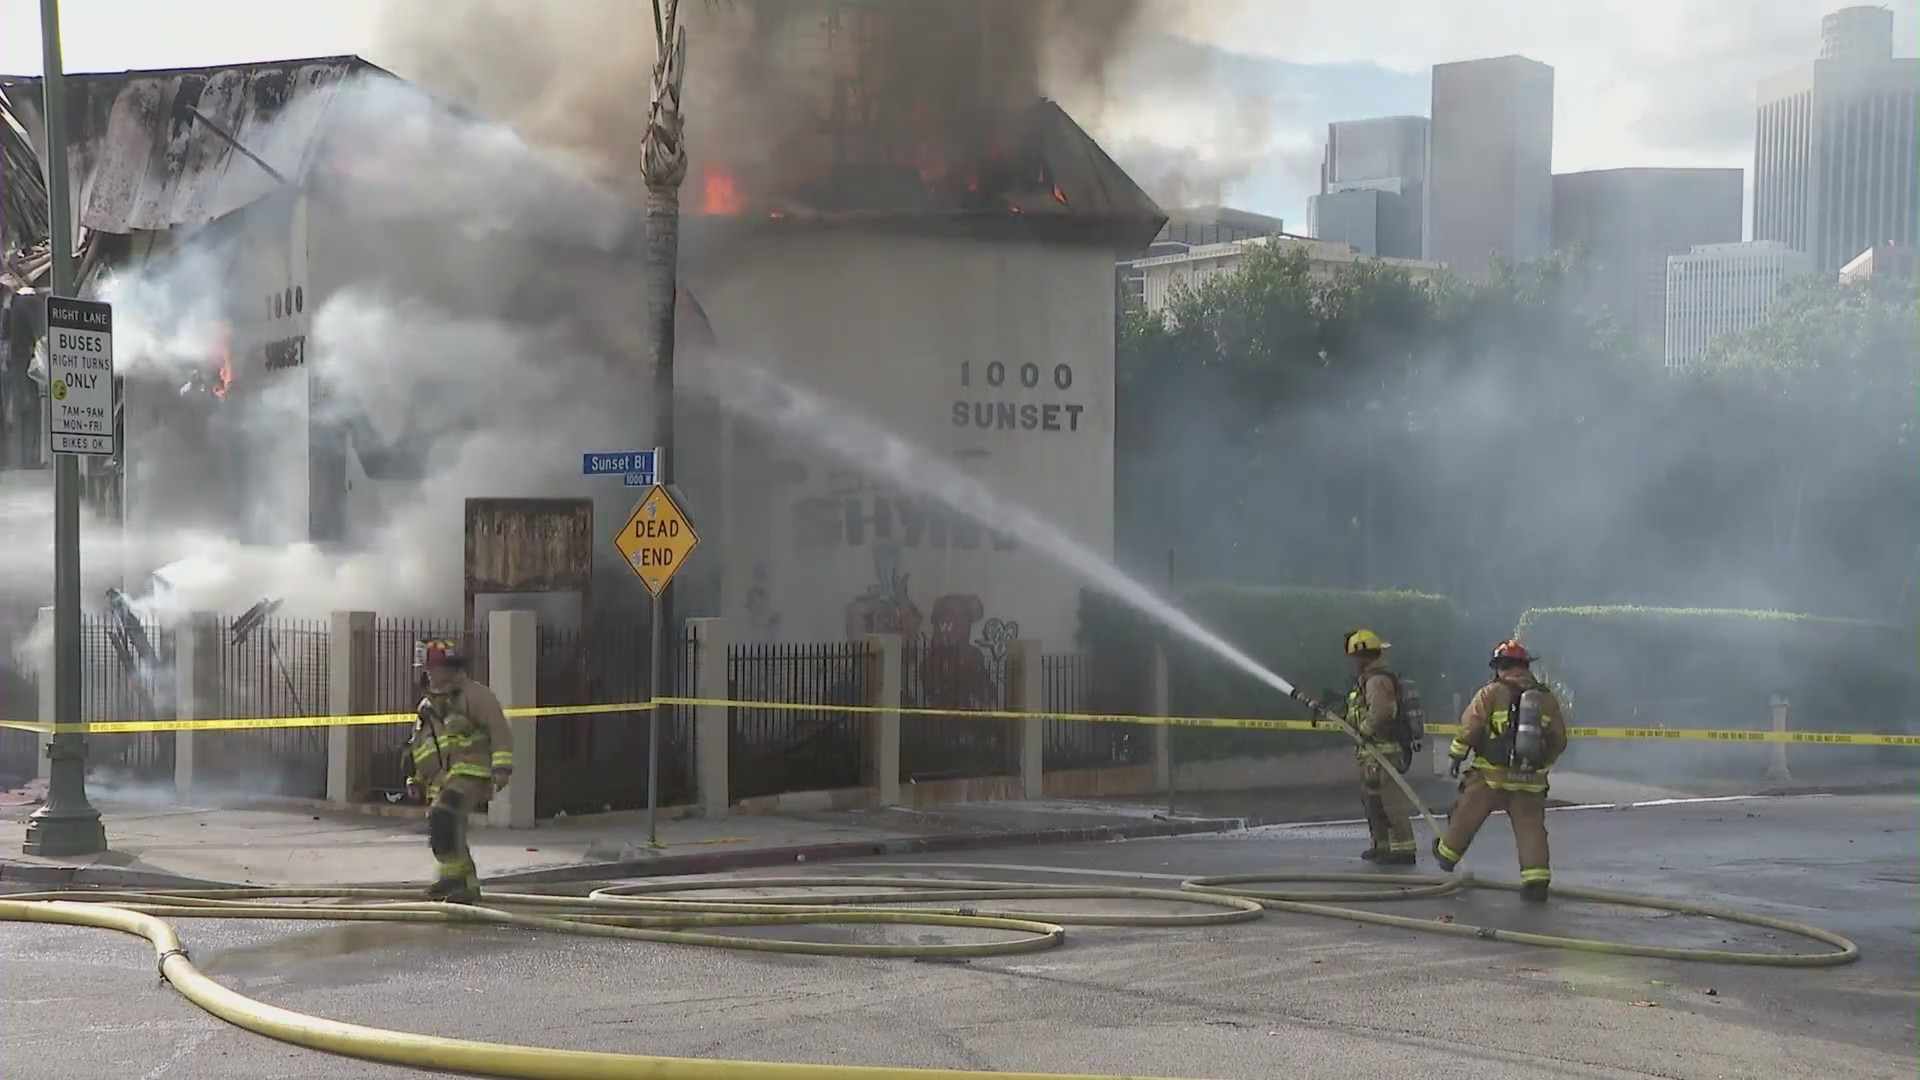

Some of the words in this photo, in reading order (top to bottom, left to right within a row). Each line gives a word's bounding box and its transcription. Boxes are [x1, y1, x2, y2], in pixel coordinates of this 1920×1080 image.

[266, 285, 303, 321] 1000
[52, 307, 79, 321] RIGHT
[83, 311, 107, 324] LANE
[59, 333, 102, 352] BUSES
[52, 353, 78, 369] RIGHT
[82, 356, 110, 371] TURNS
[65, 372, 97, 389] ONLY
[961, 360, 1073, 390] 1000
[63, 419, 102, 432] MON-FRI
[951, 401, 1084, 432] SUNSET
[62, 437, 88, 449] BIKES
[92, 439, 104, 449] OK
[591, 455, 629, 471] Sunset
[634, 454, 646, 469] Bl
[626, 474, 644, 485] 1000
[645, 475, 651, 484] W
[635, 520, 679, 538] DEAD
[642, 548, 673, 566] END
